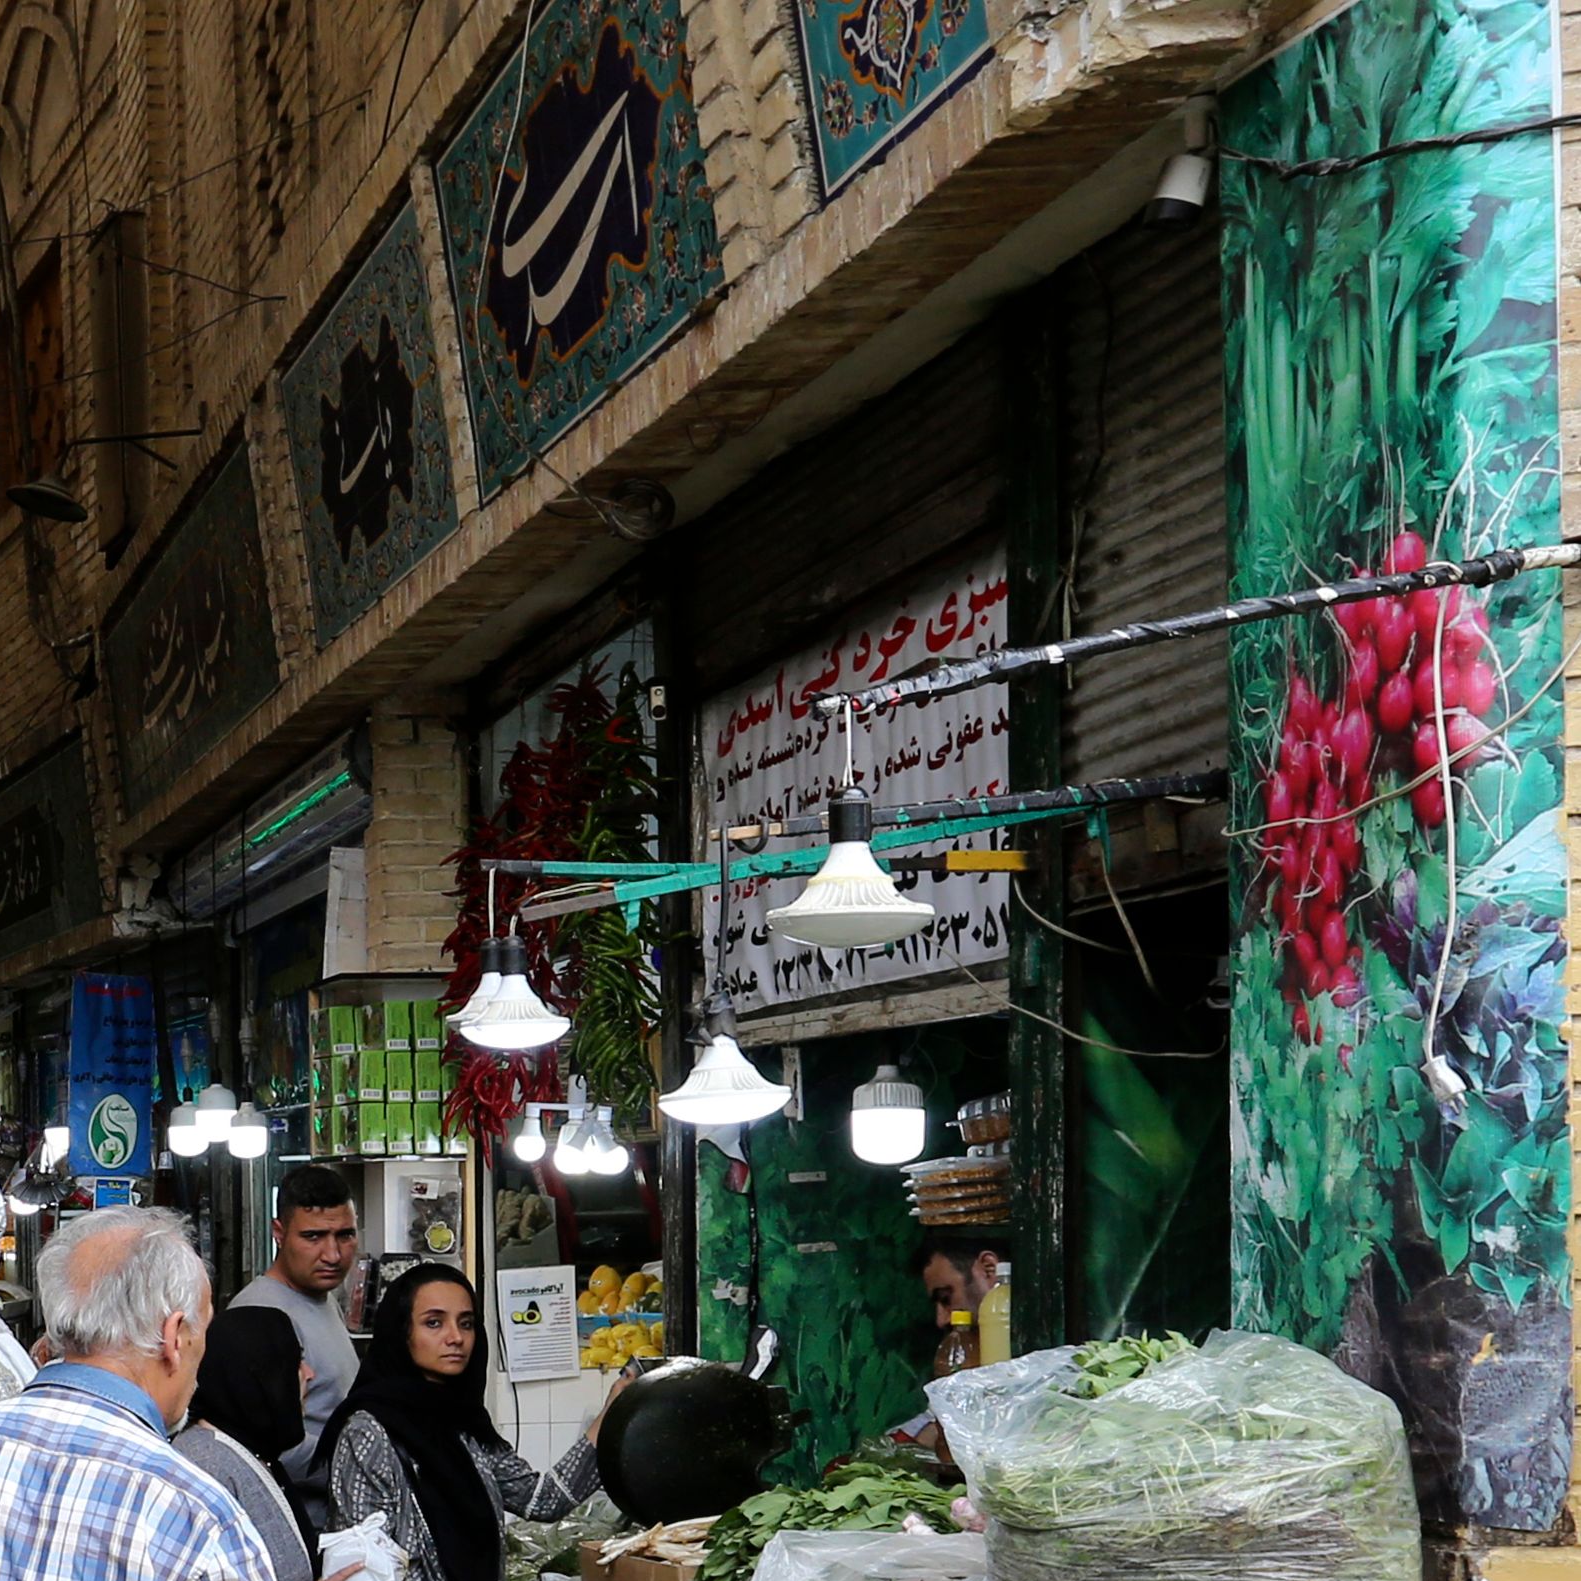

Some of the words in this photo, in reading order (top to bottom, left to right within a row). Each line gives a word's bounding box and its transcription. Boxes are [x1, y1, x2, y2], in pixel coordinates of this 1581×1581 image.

[852, 598, 917, 683] خرد
[925, 573, 1009, 653] سبزی
[717, 664, 785, 758] اسدی
[927, 716, 985, 771] عفونی
[884, 736, 923, 777] شده
